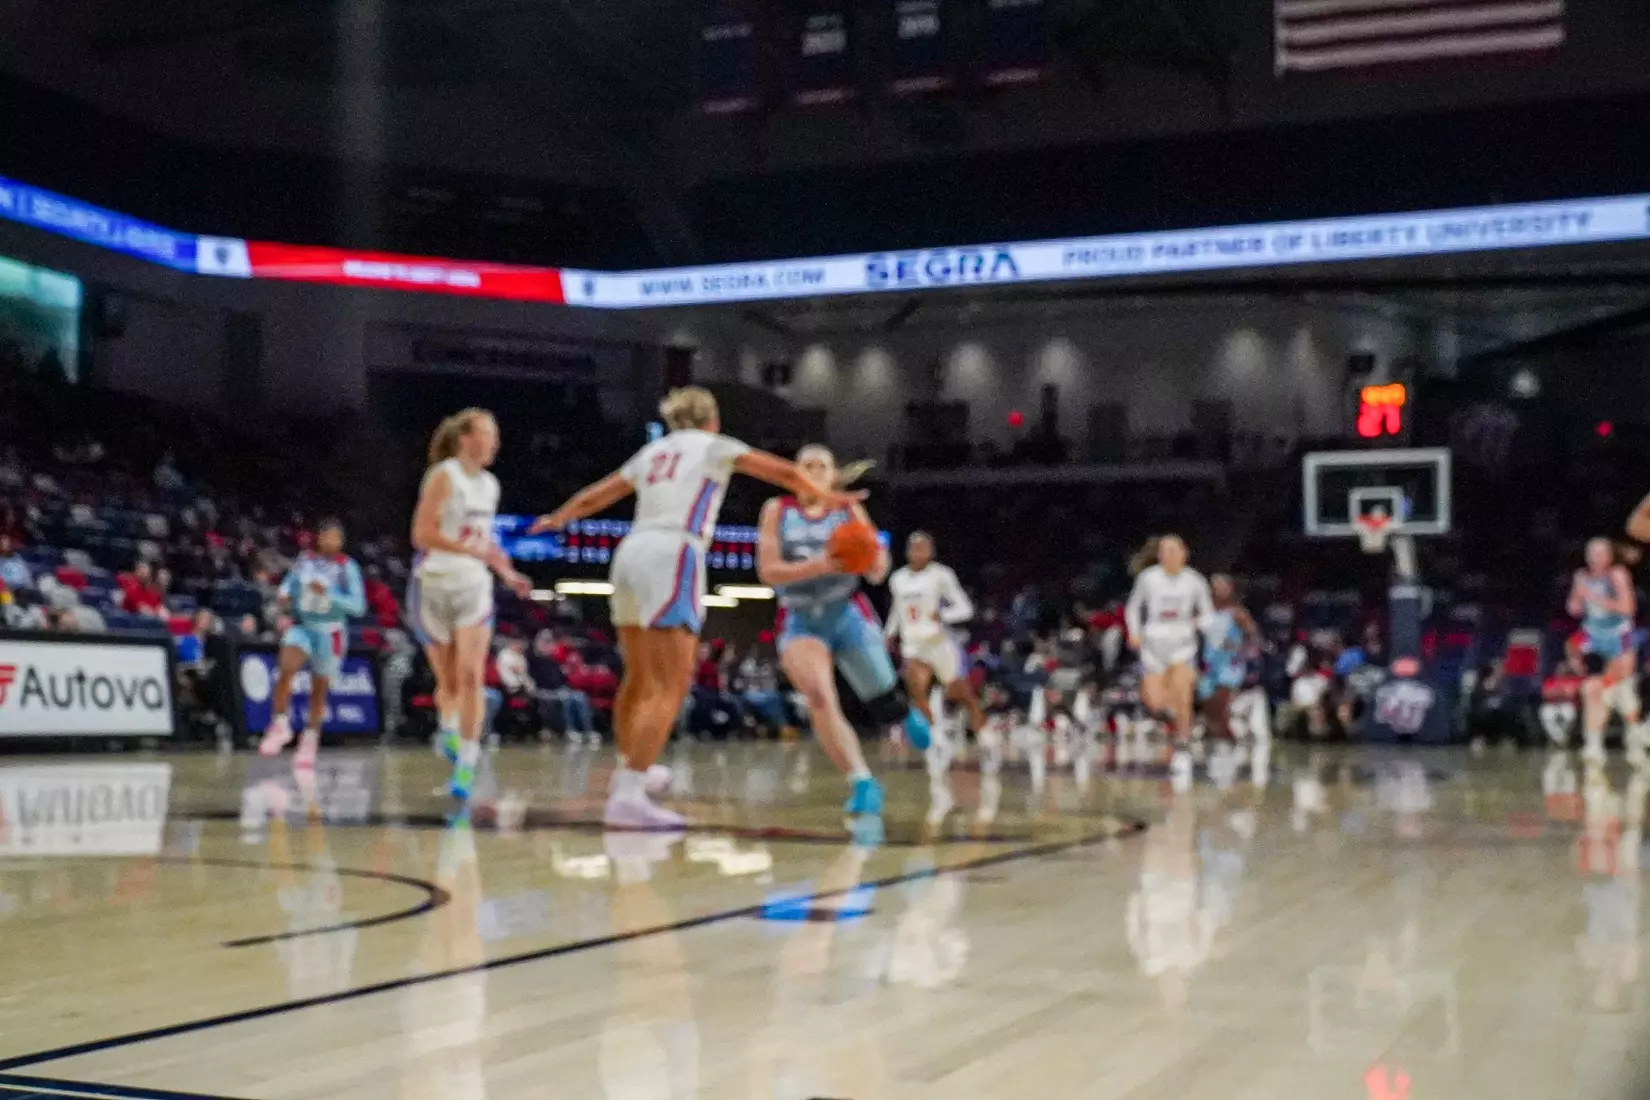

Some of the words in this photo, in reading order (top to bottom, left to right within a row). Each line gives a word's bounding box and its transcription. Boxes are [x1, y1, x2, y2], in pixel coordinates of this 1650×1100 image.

[1151, 236, 1265, 259] PARTNER
[1310, 225, 1418, 248] LIBERTY
[1426, 210, 1594, 241] UNIVERSITY
[866, 247, 1021, 288] SEGRA
[646, 451, 682, 486] 21
